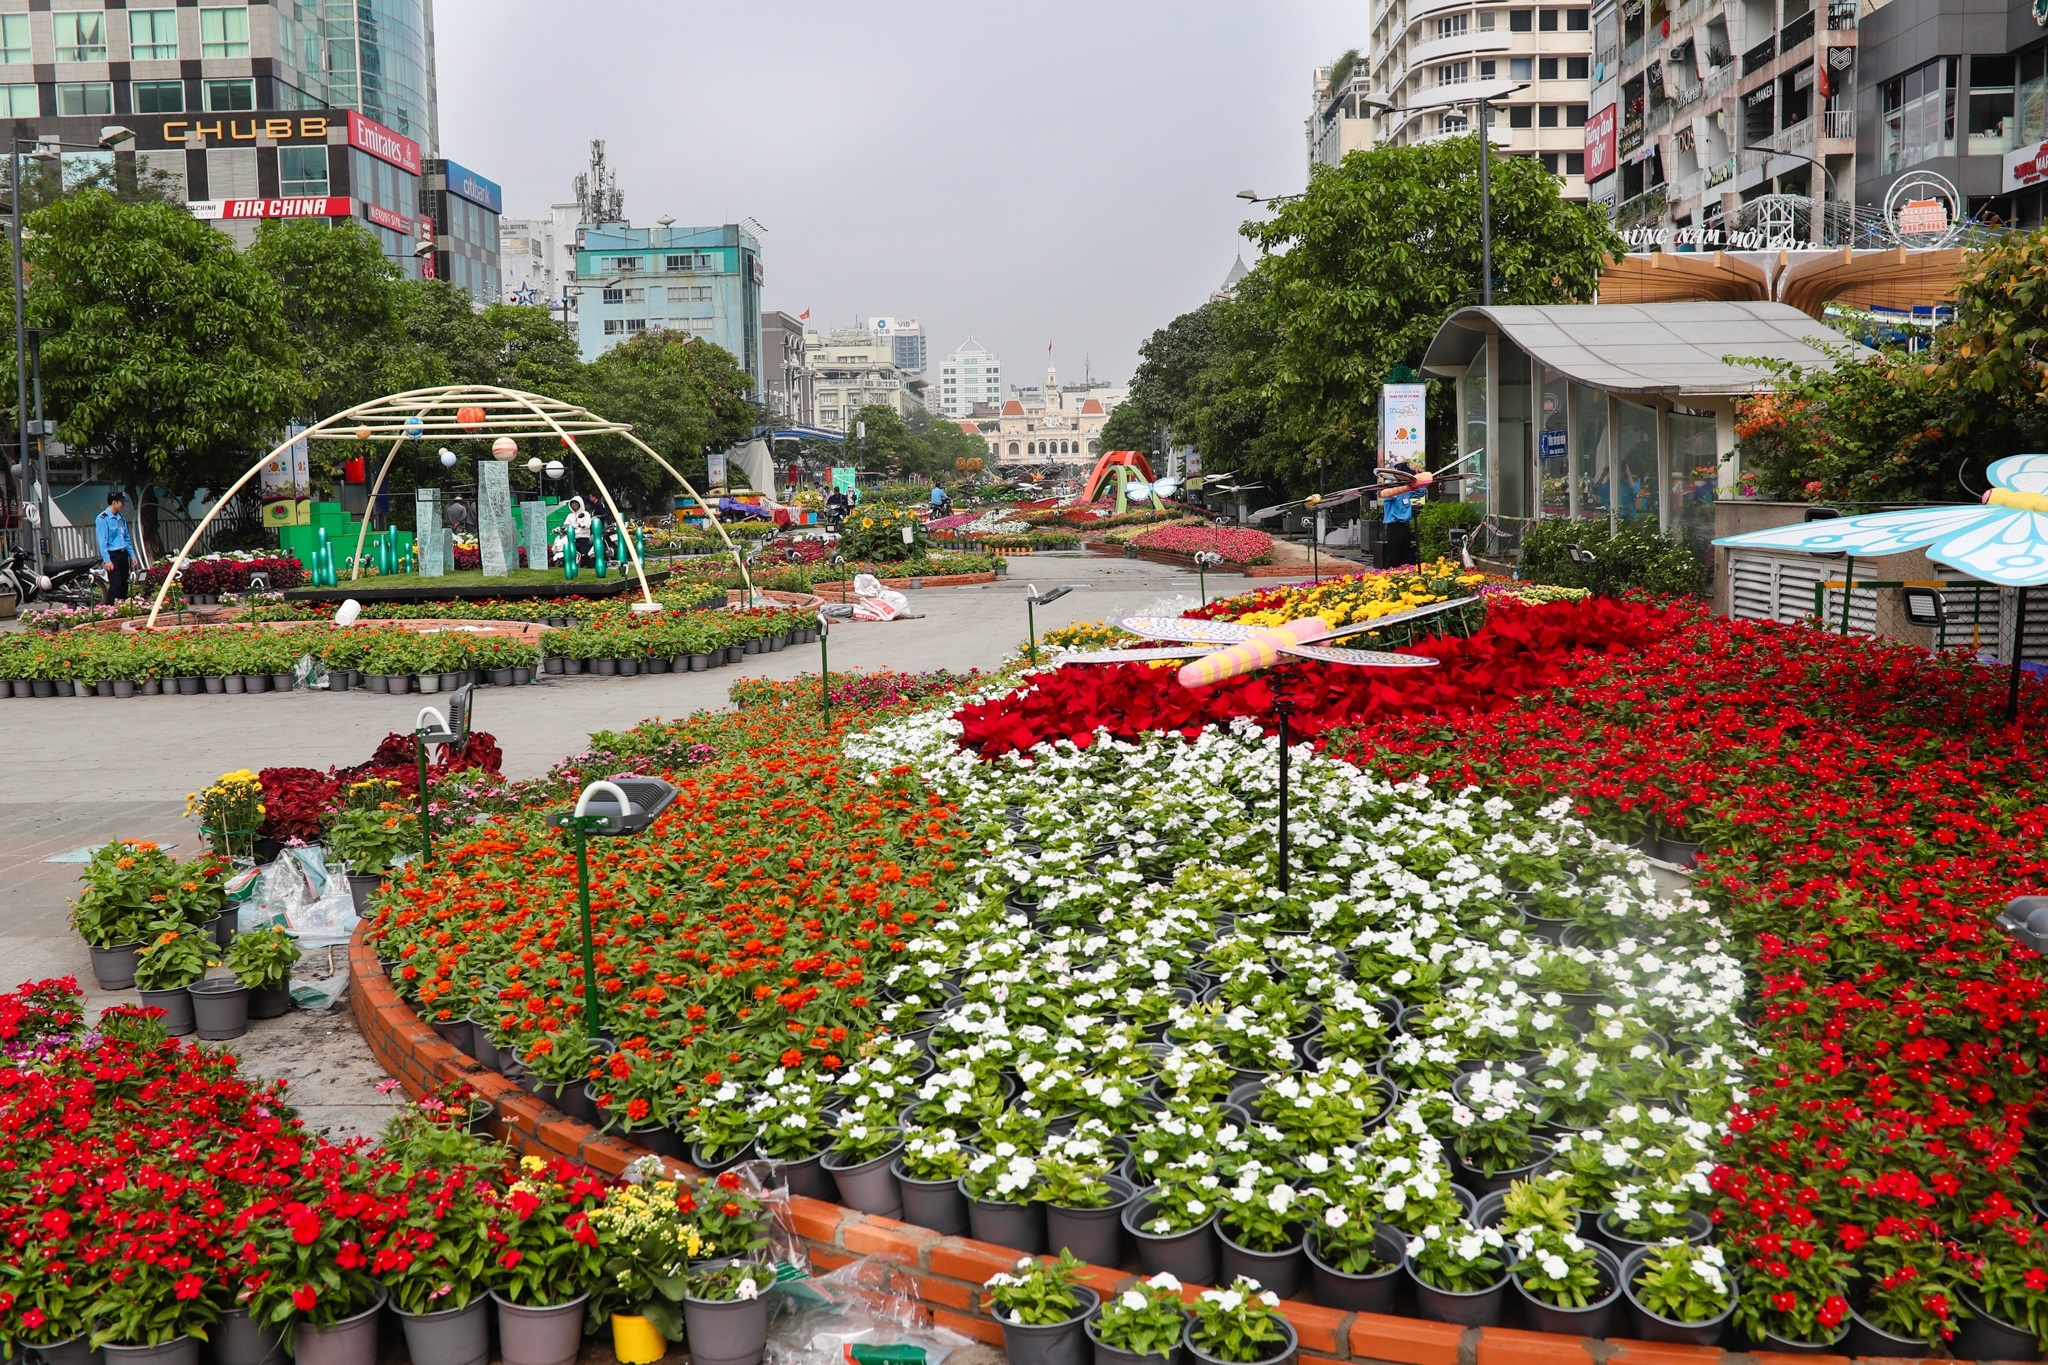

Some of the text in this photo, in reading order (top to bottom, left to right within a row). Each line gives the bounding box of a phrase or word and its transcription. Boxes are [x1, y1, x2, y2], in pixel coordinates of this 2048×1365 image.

[163, 117, 328, 142] CHUBB
[357, 118, 402, 162] Emirates
[463, 177, 491, 206] citibank
[232, 199, 327, 217] AIR CHINA
[1677, 222, 1720, 246] NĂM
